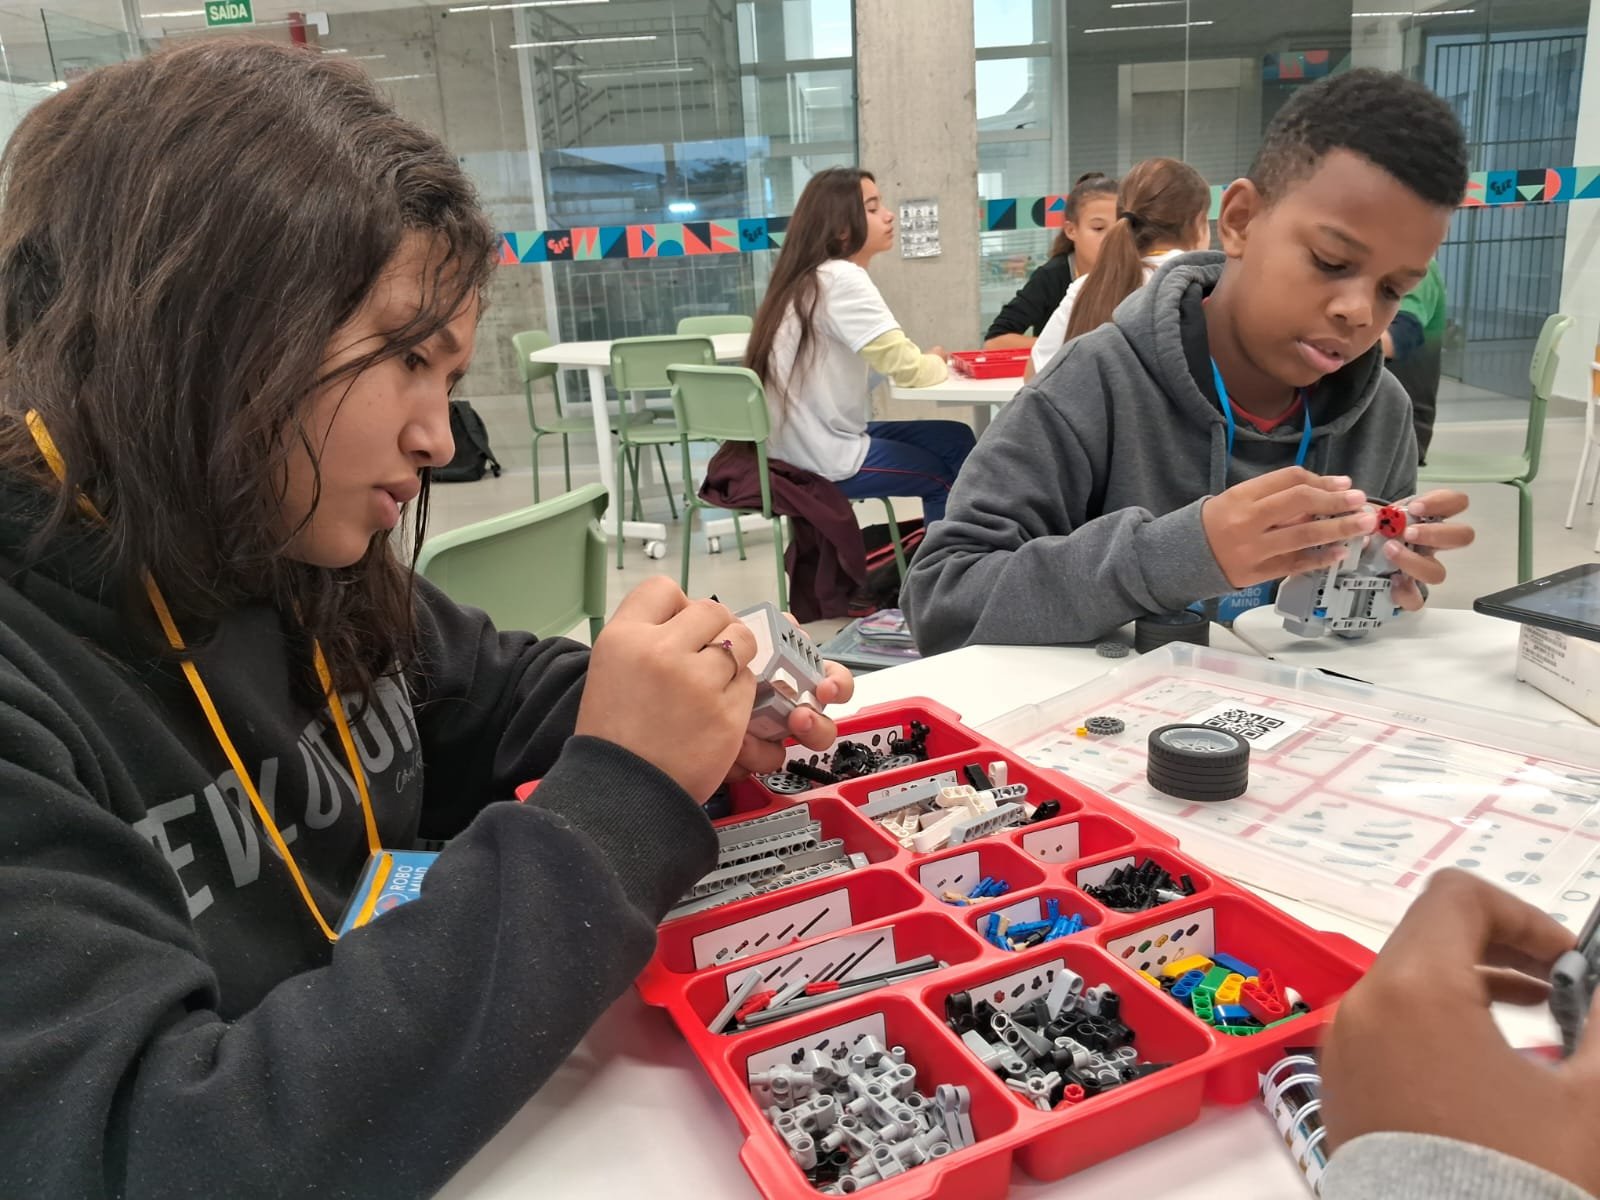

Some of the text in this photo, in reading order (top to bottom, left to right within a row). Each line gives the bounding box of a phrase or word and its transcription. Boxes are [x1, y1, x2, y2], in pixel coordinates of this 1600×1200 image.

[209, 0, 249, 20] SAÍDA
[1231, 598, 1260, 608] MIND
[133, 659, 421, 920] EVOLUTON
[389, 865, 413, 891] ROBO
[407, 866, 428, 894] MIND
